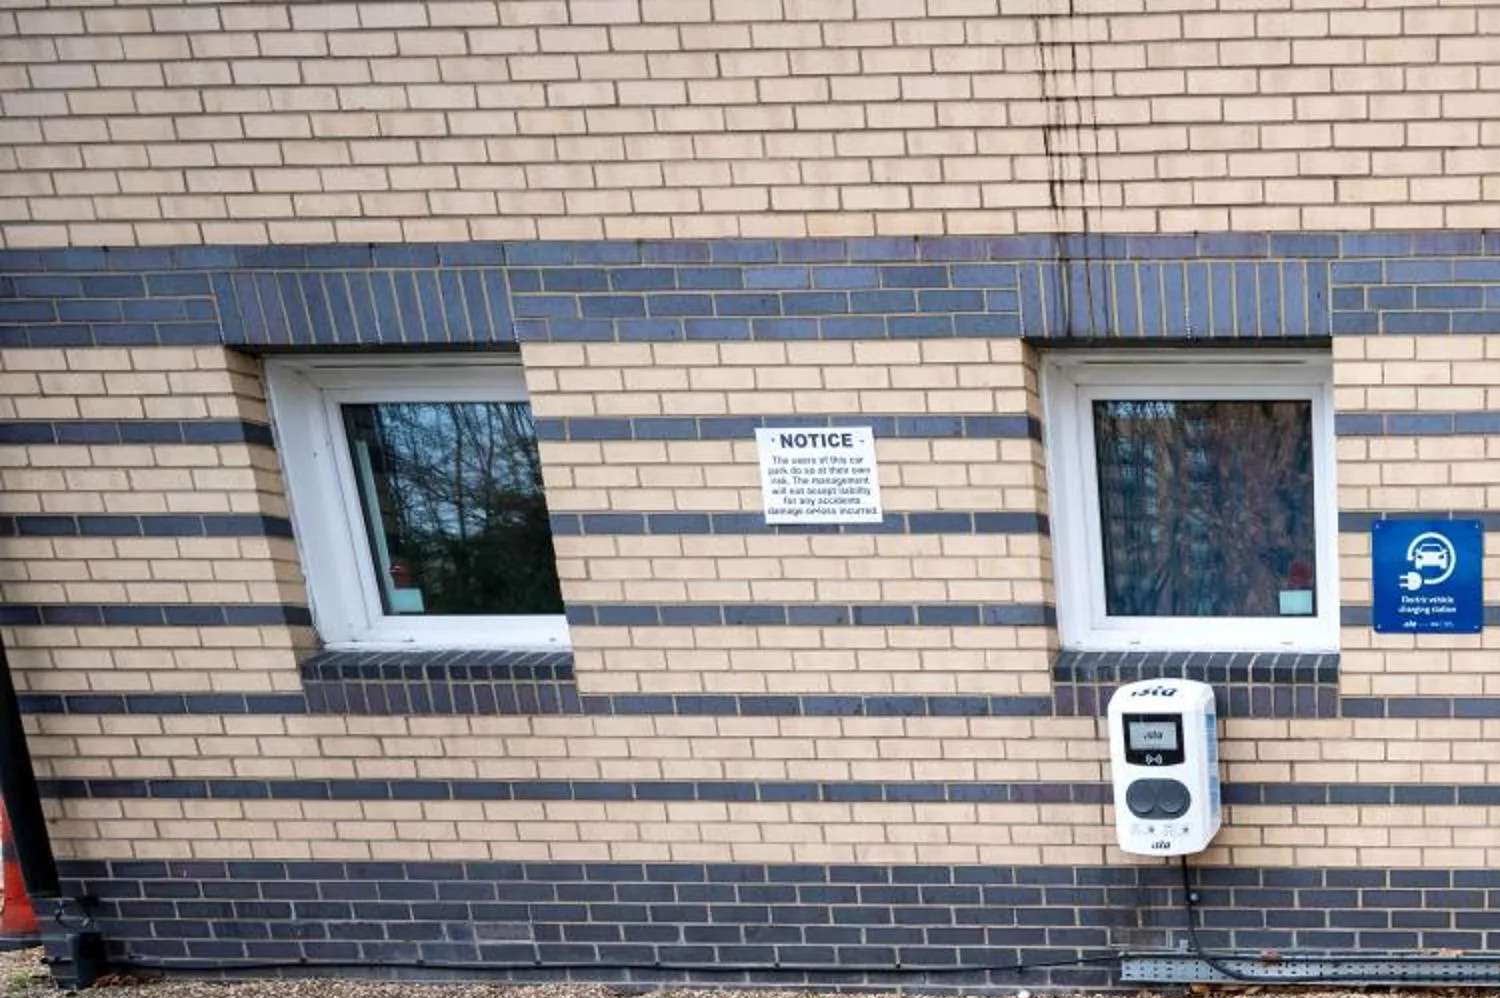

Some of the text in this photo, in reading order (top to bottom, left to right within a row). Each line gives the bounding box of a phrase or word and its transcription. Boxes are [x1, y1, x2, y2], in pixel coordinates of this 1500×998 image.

[780, 433, 853, 448] NOTICE
[1401, 595, 1454, 604] Electric vehicle
[1398, 605, 1457, 615] charging station
[1131, 685, 1178, 697] ista
